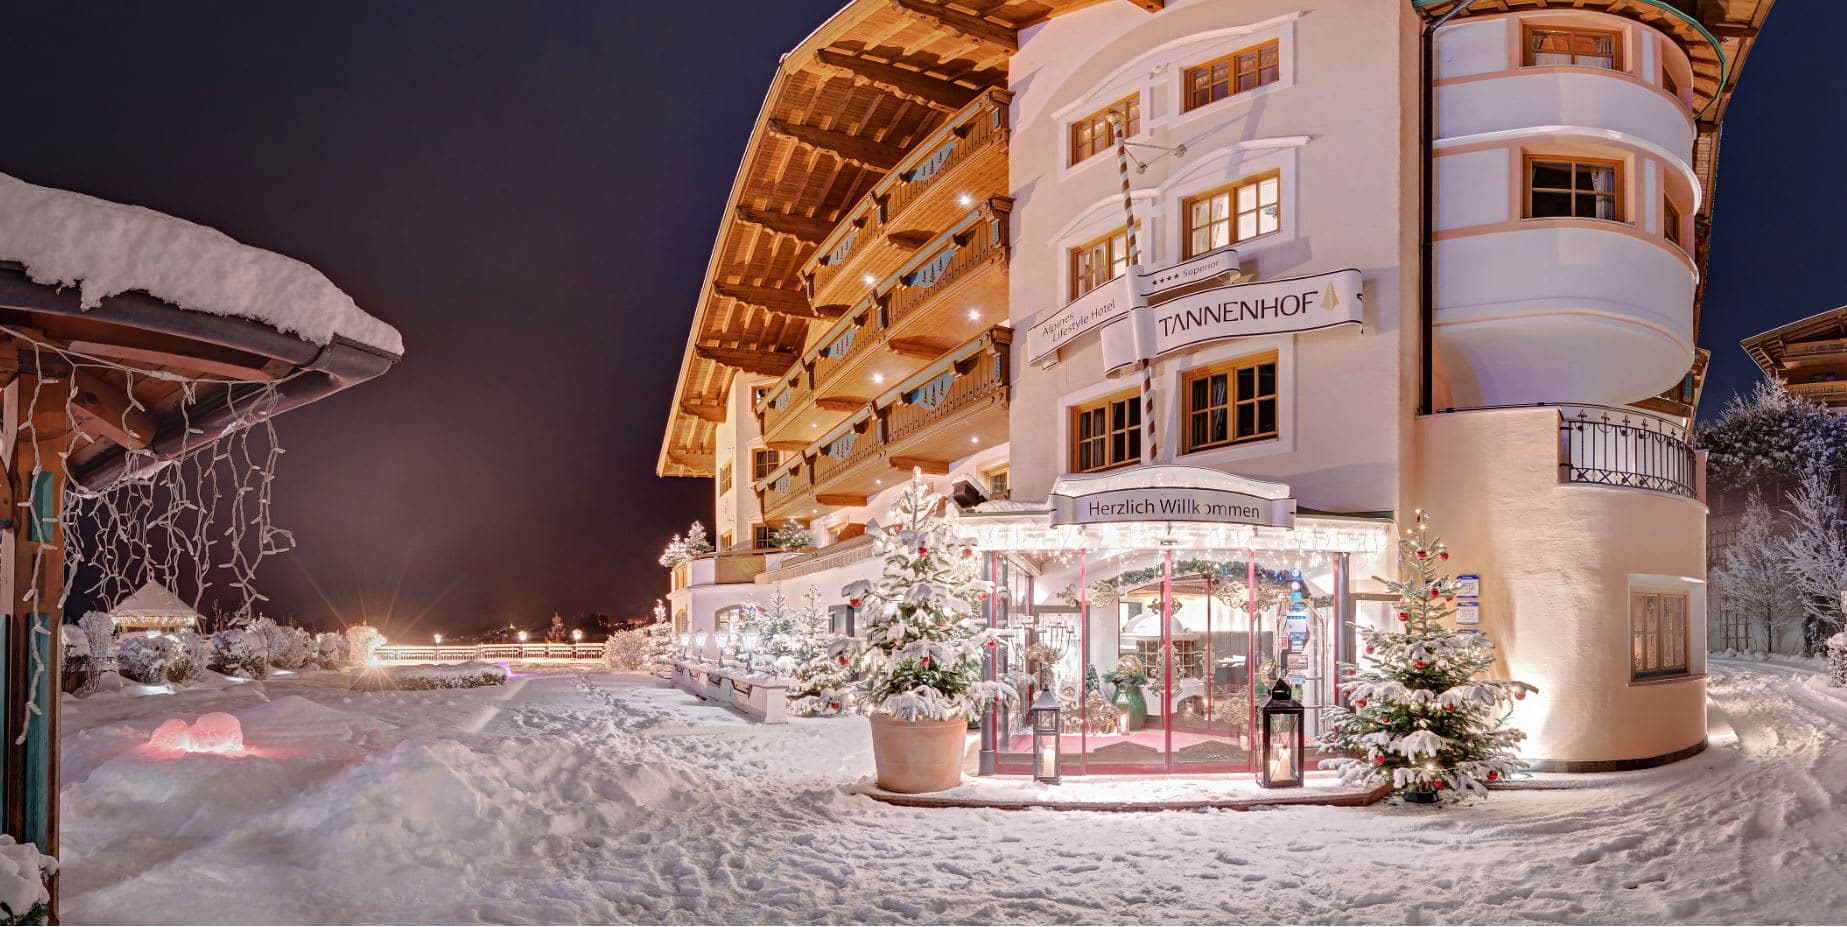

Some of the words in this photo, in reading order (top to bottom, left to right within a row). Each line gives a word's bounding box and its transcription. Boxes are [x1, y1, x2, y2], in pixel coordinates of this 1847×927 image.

[1183, 260, 1219, 277] Superior
[1042, 312, 1074, 336] Alpines
[1052, 315, 1089, 342] Lifestyle
[1091, 298, 1116, 320] Hotel
[1158, 290, 1319, 337] TANNENHOF
[1089, 498, 1155, 516] Herzlich
[1160, 498, 1260, 518] Willkommen
